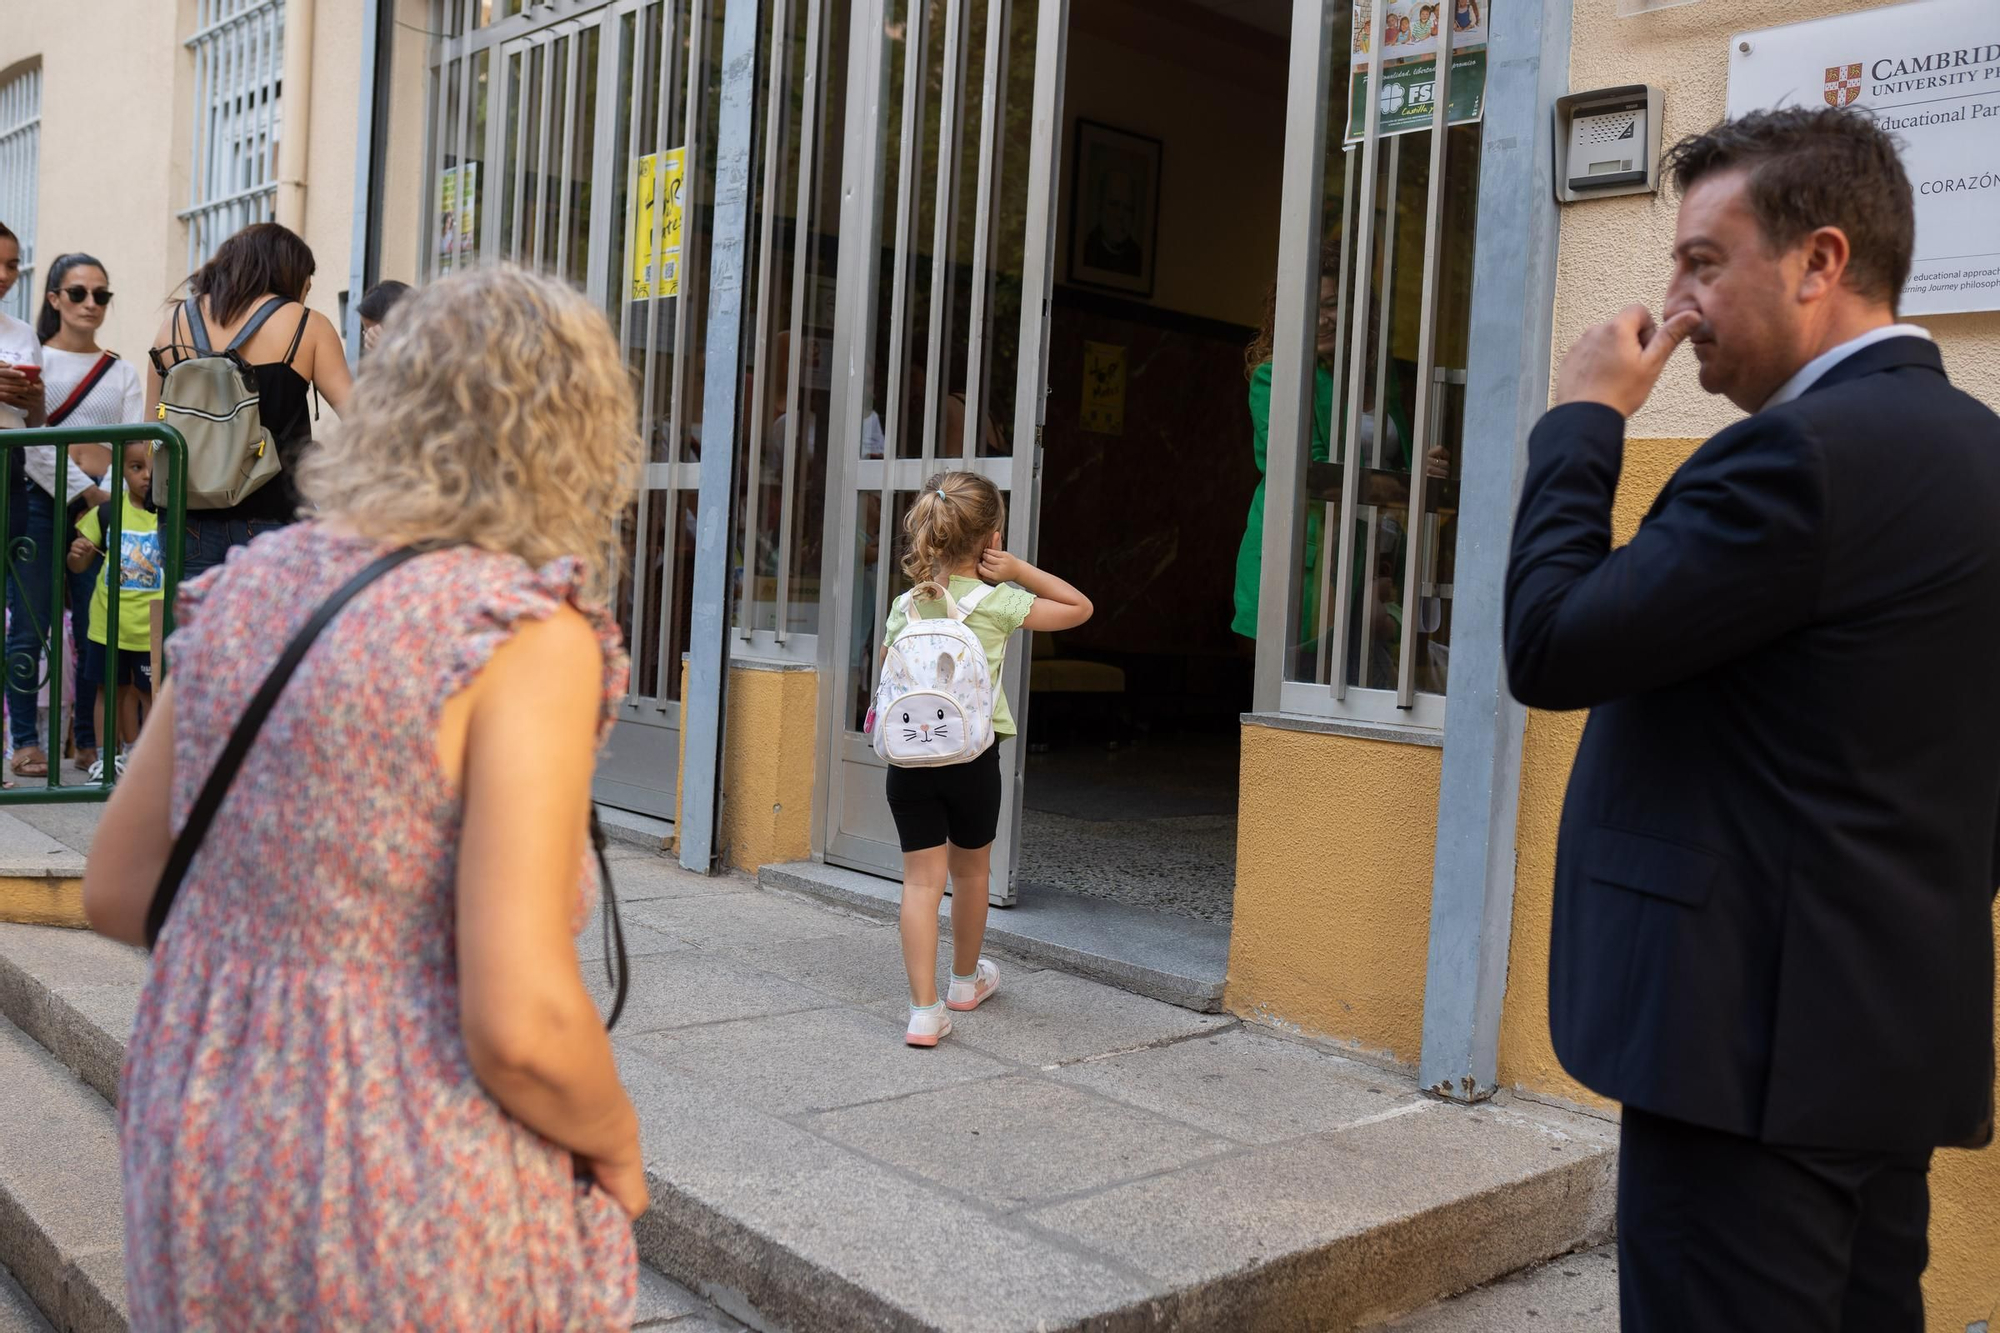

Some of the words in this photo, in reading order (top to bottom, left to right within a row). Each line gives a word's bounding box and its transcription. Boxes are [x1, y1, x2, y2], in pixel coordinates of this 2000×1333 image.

[1871, 44, 2000, 81] CAMBRID
[1872, 70, 1979, 97] UNIVERSITY
[1913, 270, 1961, 282] educational
[1928, 282, 1959, 292] Journey
